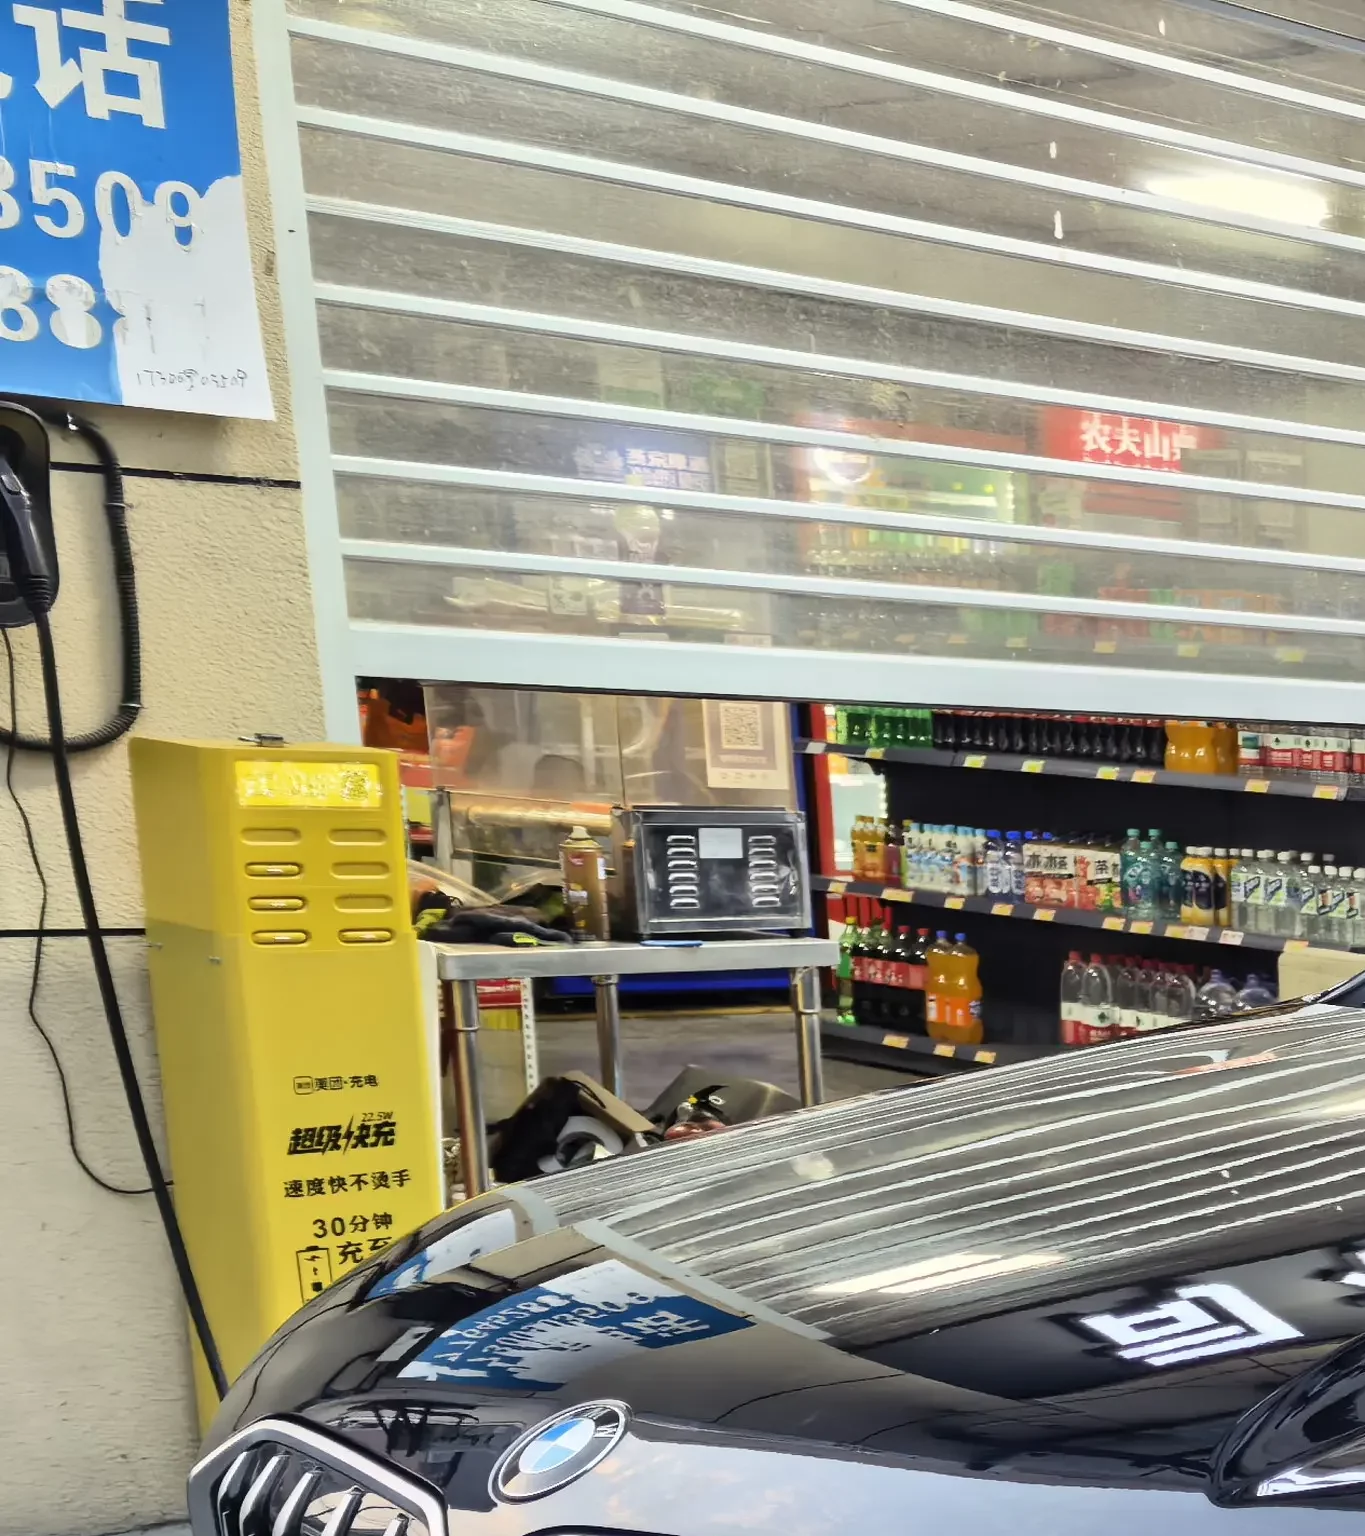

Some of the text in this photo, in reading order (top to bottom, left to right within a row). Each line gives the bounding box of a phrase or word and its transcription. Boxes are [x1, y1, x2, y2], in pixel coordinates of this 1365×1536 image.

[0, 0, 170, 129] 话
[287, 1121, 397, 1156] 超级快充
[282, 1168, 412, 1199] 速度快不烫手
[312, 1211, 394, 1239] 30分钟
